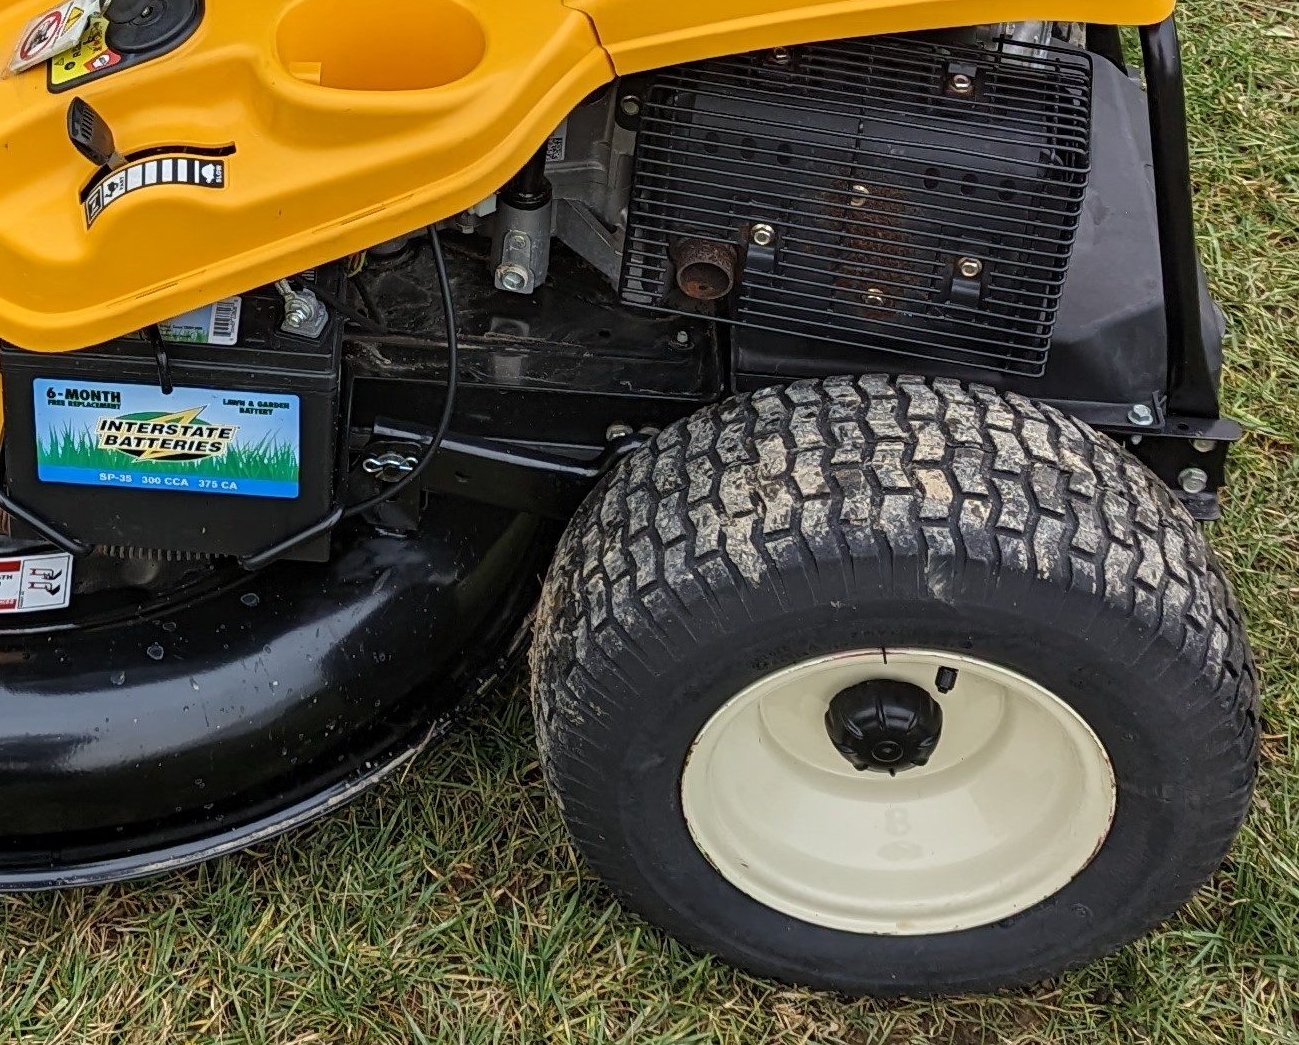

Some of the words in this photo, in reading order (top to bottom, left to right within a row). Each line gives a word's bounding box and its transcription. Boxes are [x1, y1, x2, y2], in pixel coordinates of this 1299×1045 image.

[67, 400, 121, 410] REPLACEMENT
[222, 398, 245, 407] LAWN
[256, 400, 290, 409] GARDEN
[238, 406, 274, 415] BATTERY
[100, 419, 233, 440] INTERSTATE
[103, 434, 222, 454] BATTERIES
[99, 472, 132, 484] SP-35
[141, 475, 161, 485] 300
[164, 476, 189, 487] CCA
[198, 479, 218, 489] 375
[221, 480, 238, 490] CA
